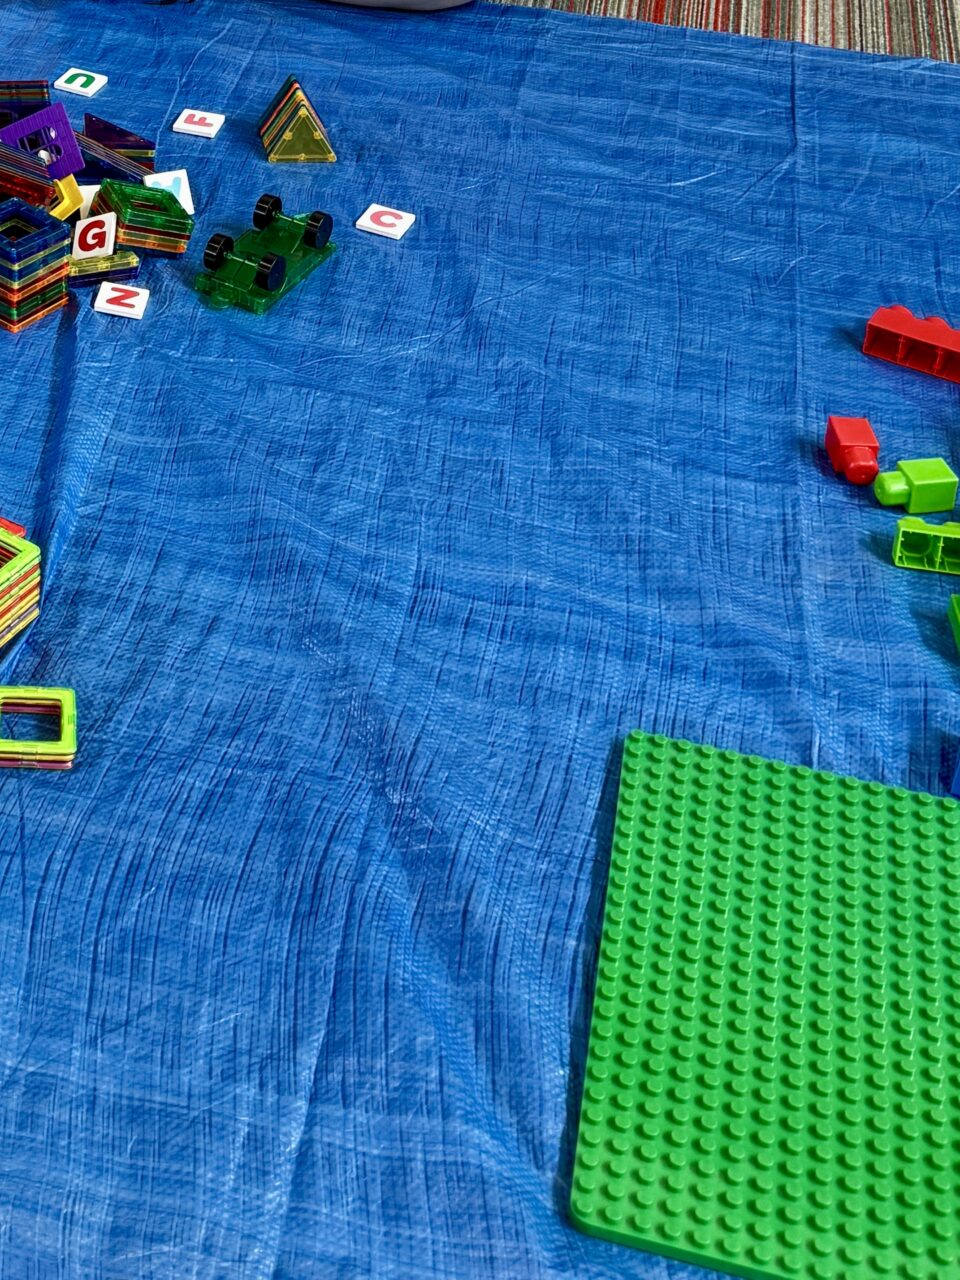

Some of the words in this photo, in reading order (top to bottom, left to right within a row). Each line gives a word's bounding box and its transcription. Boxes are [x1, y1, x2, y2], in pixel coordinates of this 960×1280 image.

[184, 113, 214, 127] F
[370, 211, 403, 227] C
[78, 220, 106, 252] G
